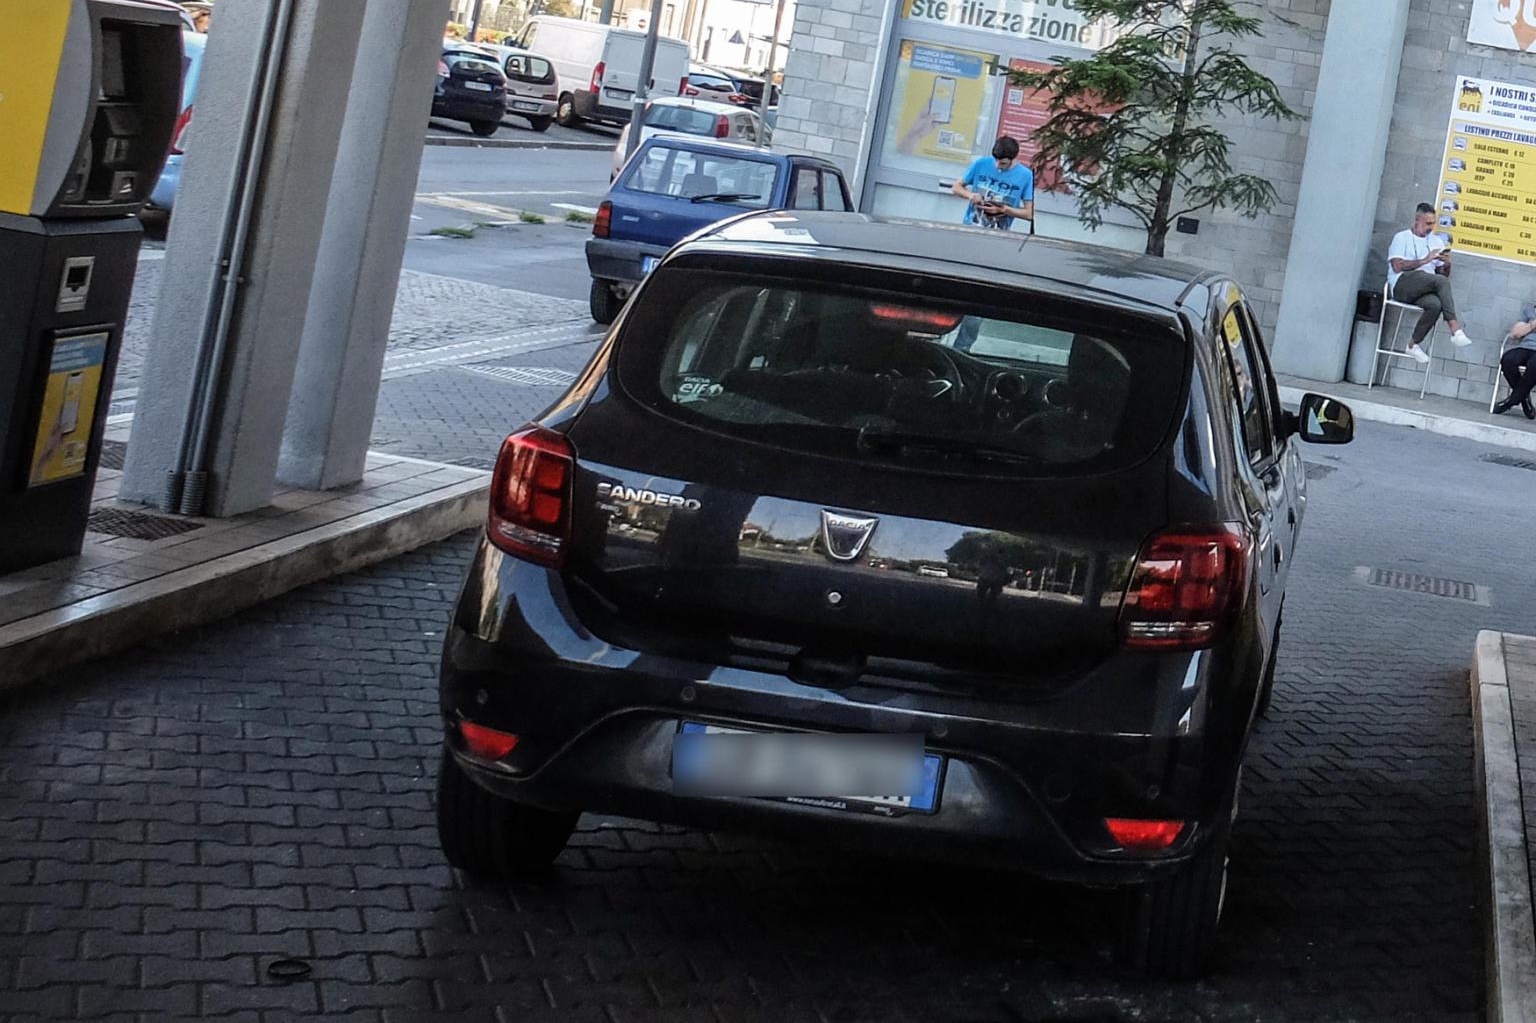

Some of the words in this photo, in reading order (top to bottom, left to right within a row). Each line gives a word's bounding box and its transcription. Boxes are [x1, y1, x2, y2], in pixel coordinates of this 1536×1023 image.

[1495, 87, 1528, 101] NOSTRI
[1459, 101, 1480, 113] eni
[1464, 124, 1490, 136] LISTINO
[1491, 129, 1512, 141] PREZZI
[596, 482, 701, 511] SANDERO
